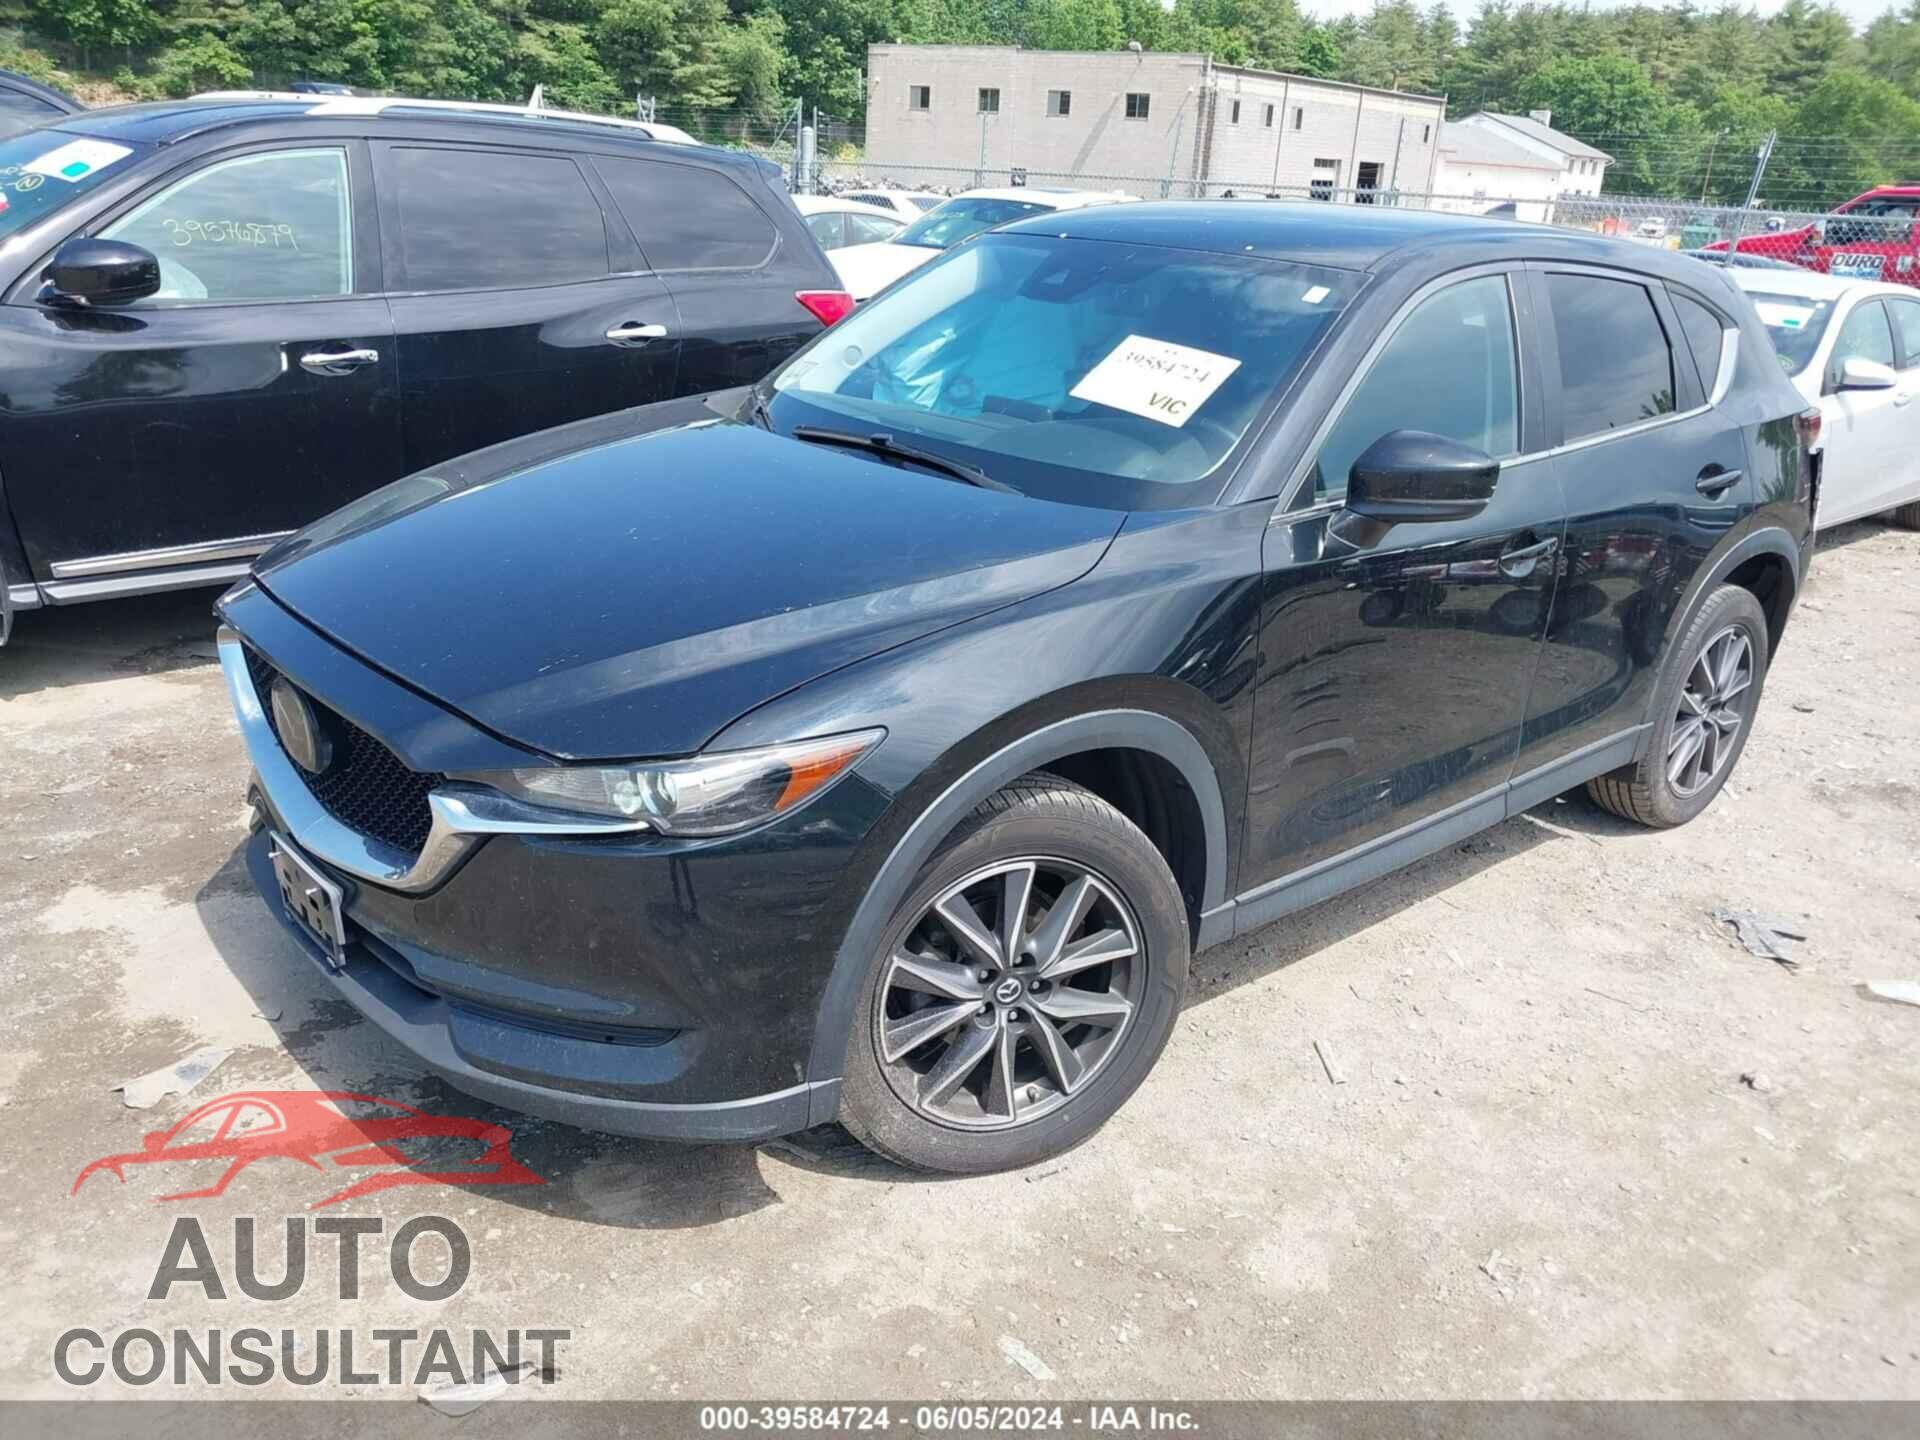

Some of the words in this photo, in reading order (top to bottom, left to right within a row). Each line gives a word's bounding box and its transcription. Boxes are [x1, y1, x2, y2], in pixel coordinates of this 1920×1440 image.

[162, 218, 299, 250] 39576879
[1832, 254, 1884, 269] DURO
[1147, 391, 1188, 416] VIC
